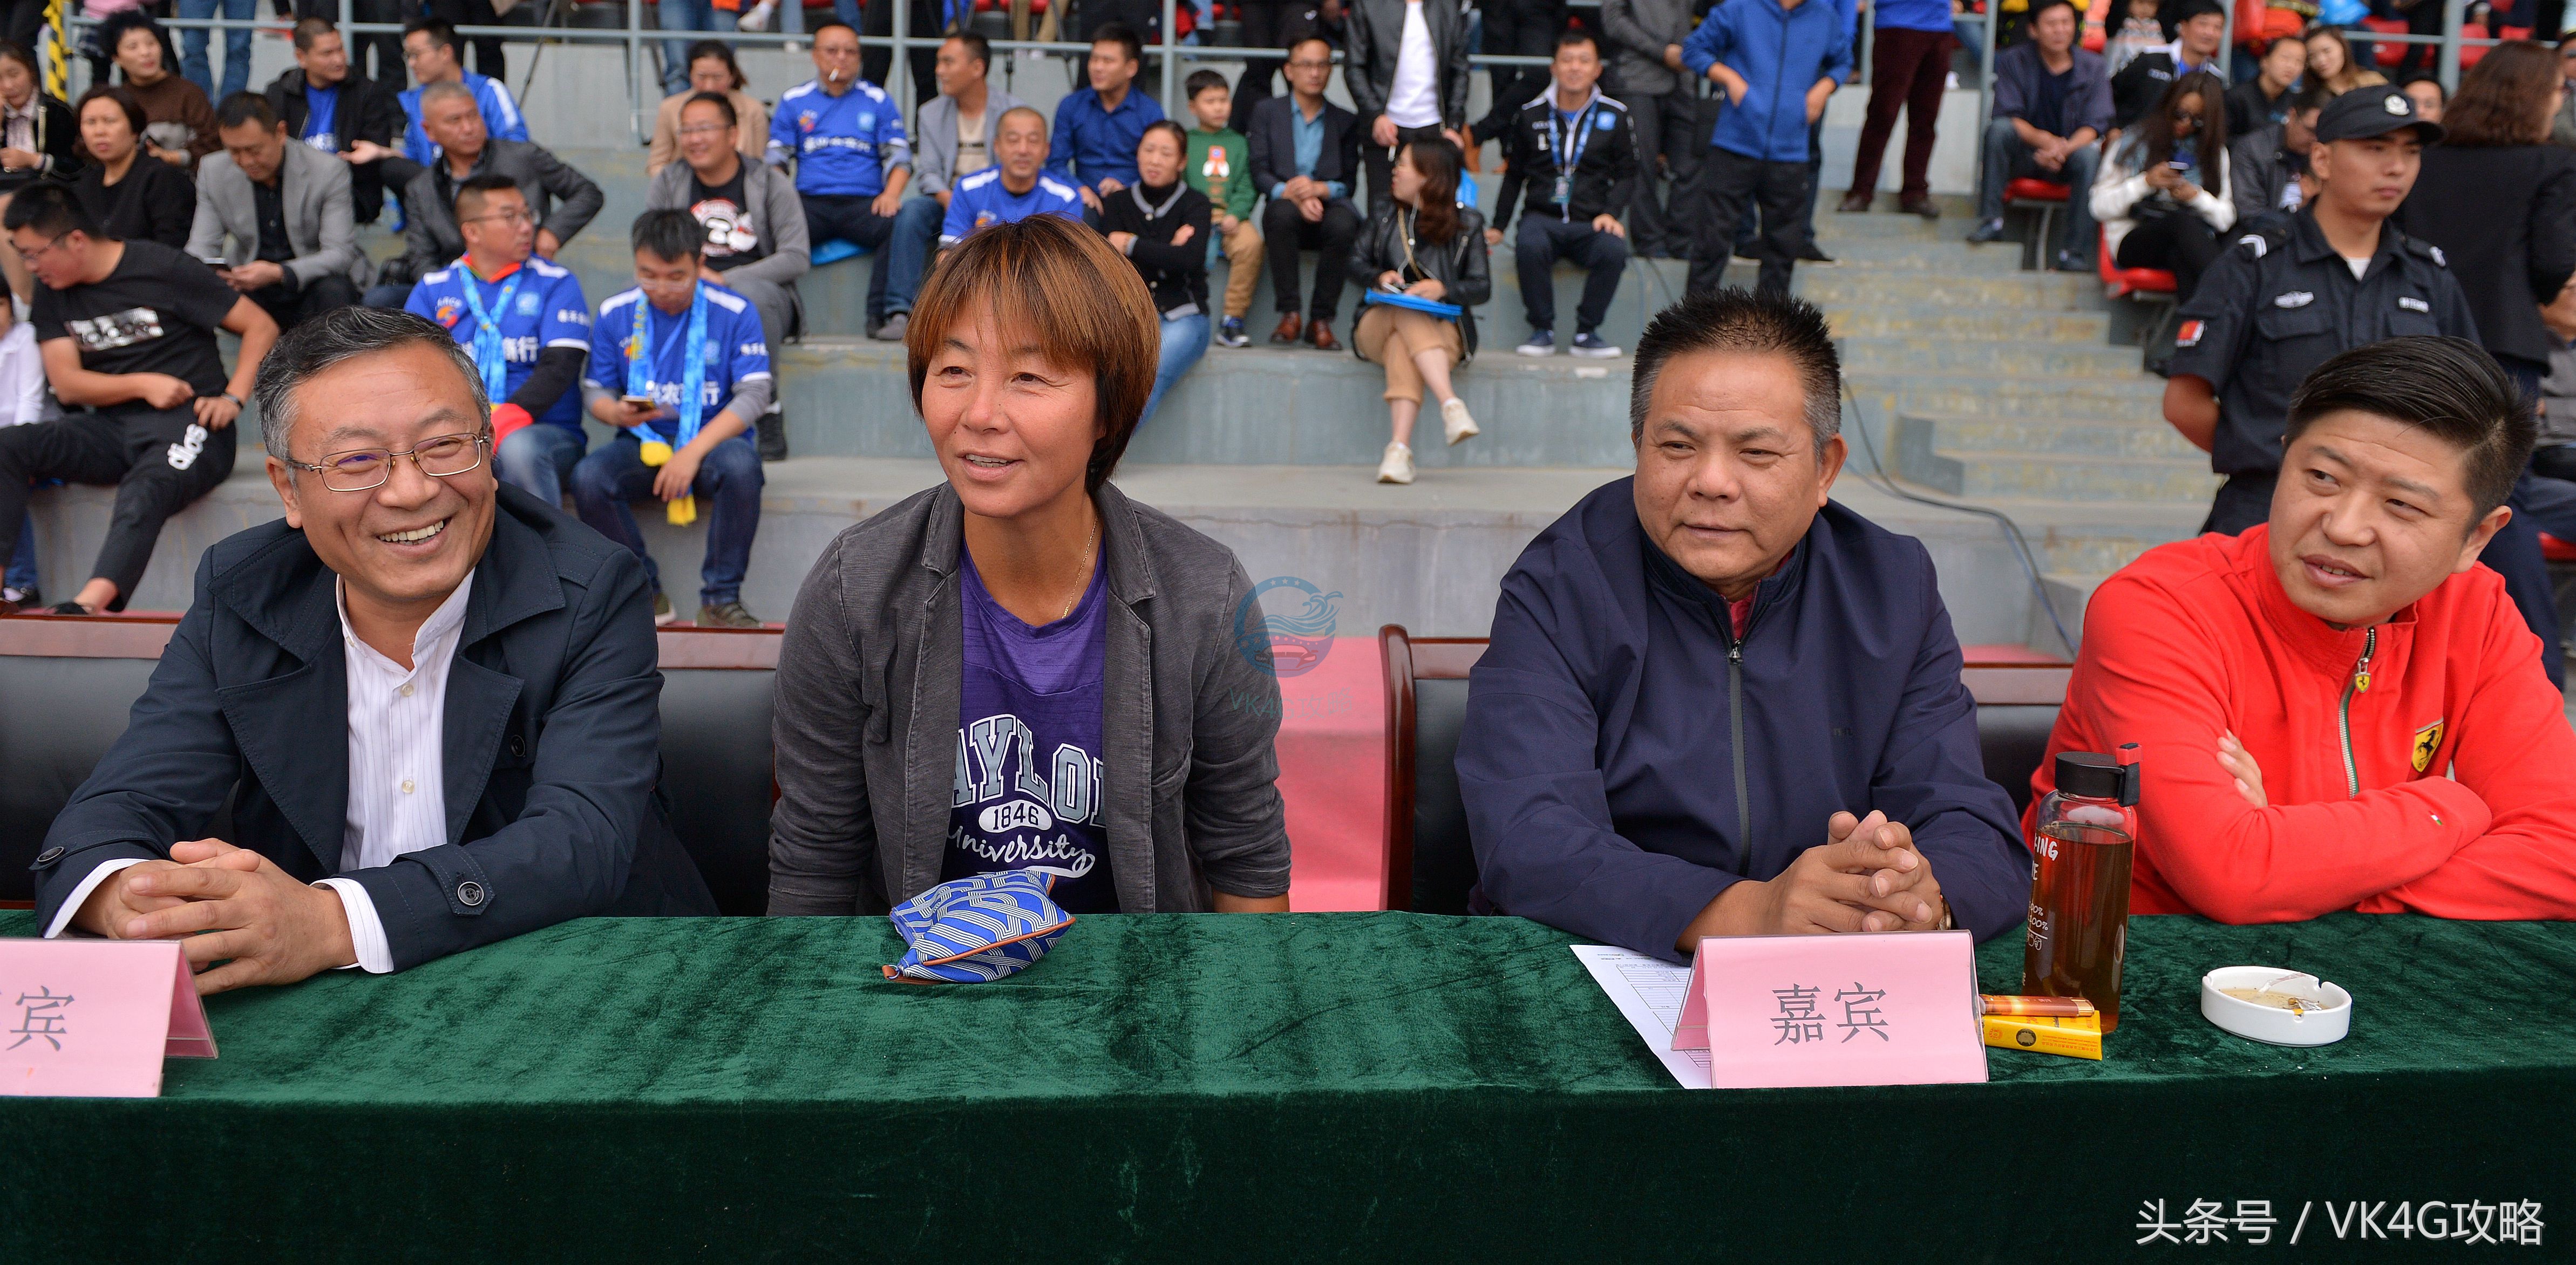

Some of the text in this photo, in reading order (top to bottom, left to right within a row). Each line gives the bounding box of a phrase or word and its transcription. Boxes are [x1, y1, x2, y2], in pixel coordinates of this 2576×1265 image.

[993, 802, 1039, 831] 1846
[0, 985, 74, 1051] 宾
[1770, 981, 1890, 1046] 嘉宾
